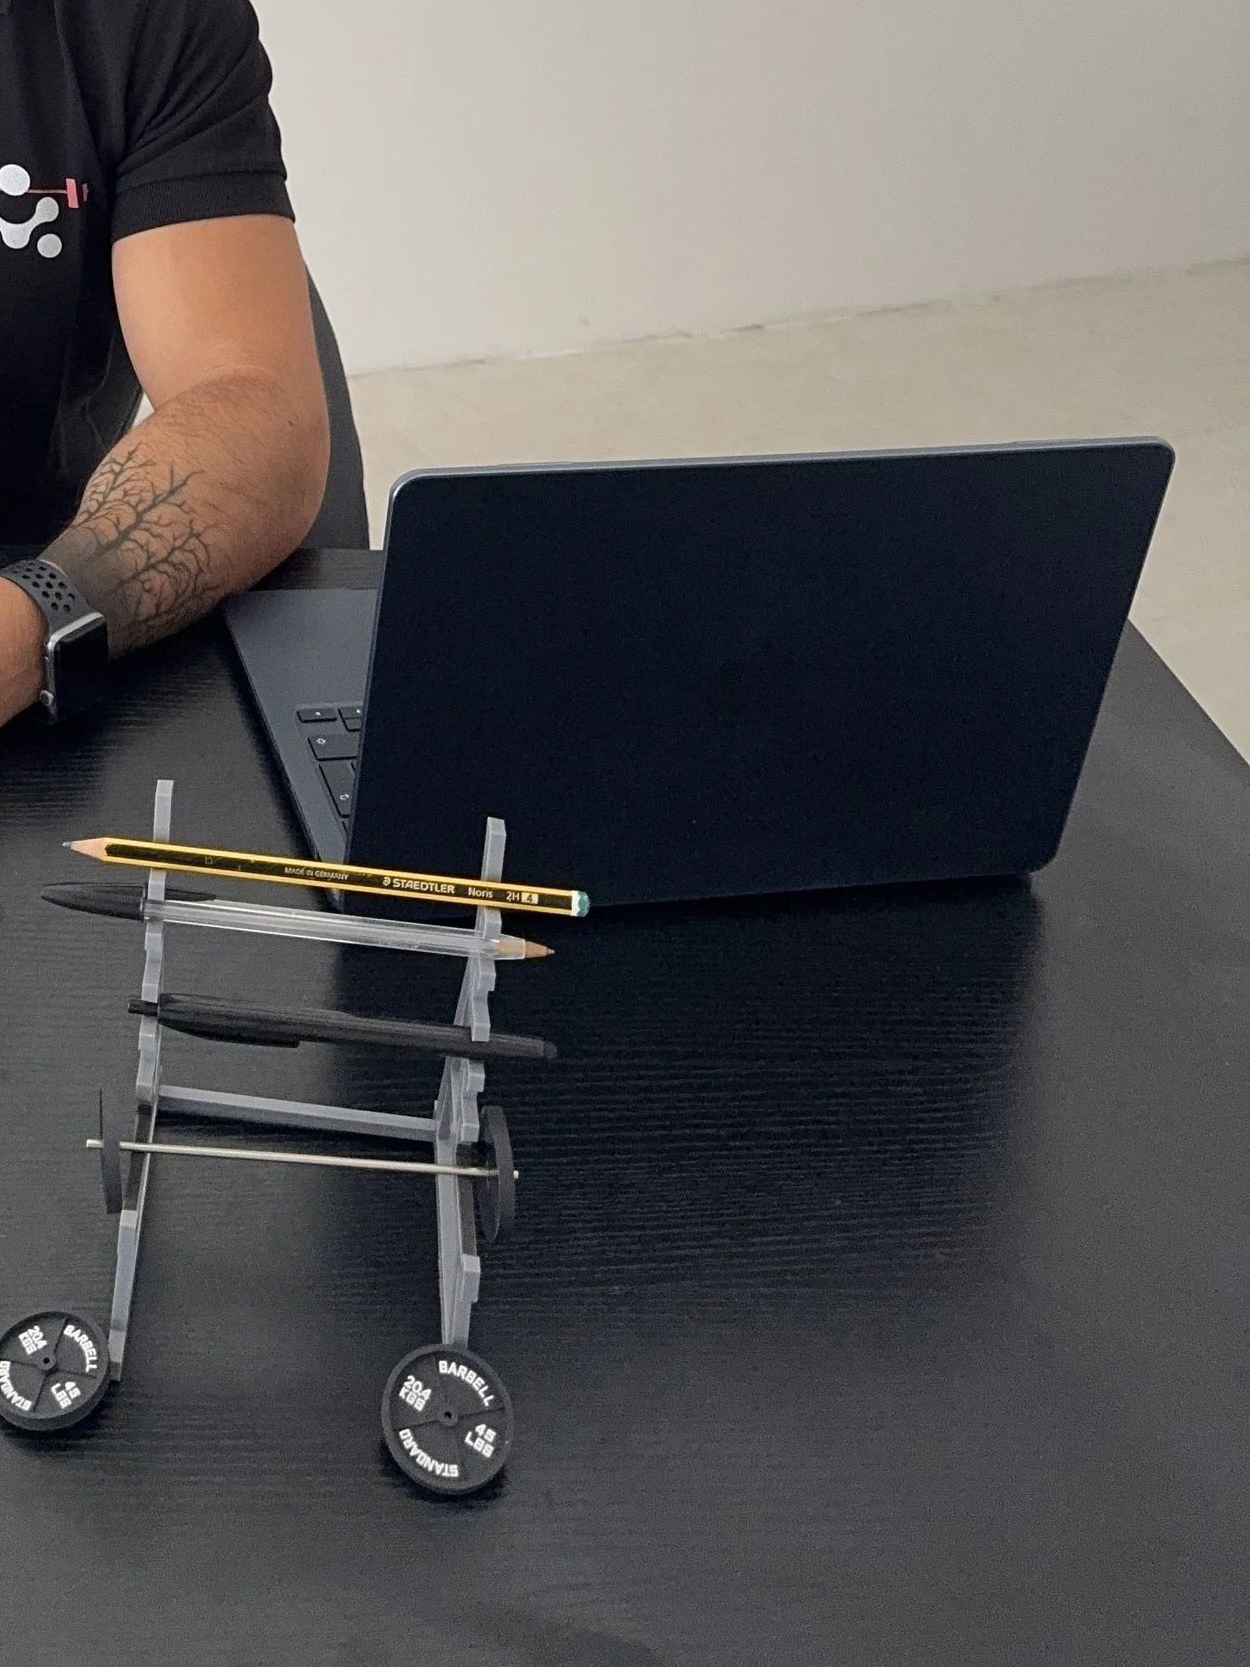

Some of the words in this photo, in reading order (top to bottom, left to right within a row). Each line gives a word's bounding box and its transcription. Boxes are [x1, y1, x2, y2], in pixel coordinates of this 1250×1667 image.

[284, 866, 306, 877] MADE
[306, 869, 314, 877] IN
[314, 870, 349, 881] GERMANY
[392, 878, 455, 895] STAEDTLER
[468, 886, 494, 900] Noris
[506, 890, 521, 902] 2H
[63, 1324, 98, 1373] BARBELL
[438, 1359, 494, 1407] BARBELL
[398, 1428, 459, 1477] STANDARD
[464, 1431, 495, 1458] LBS
